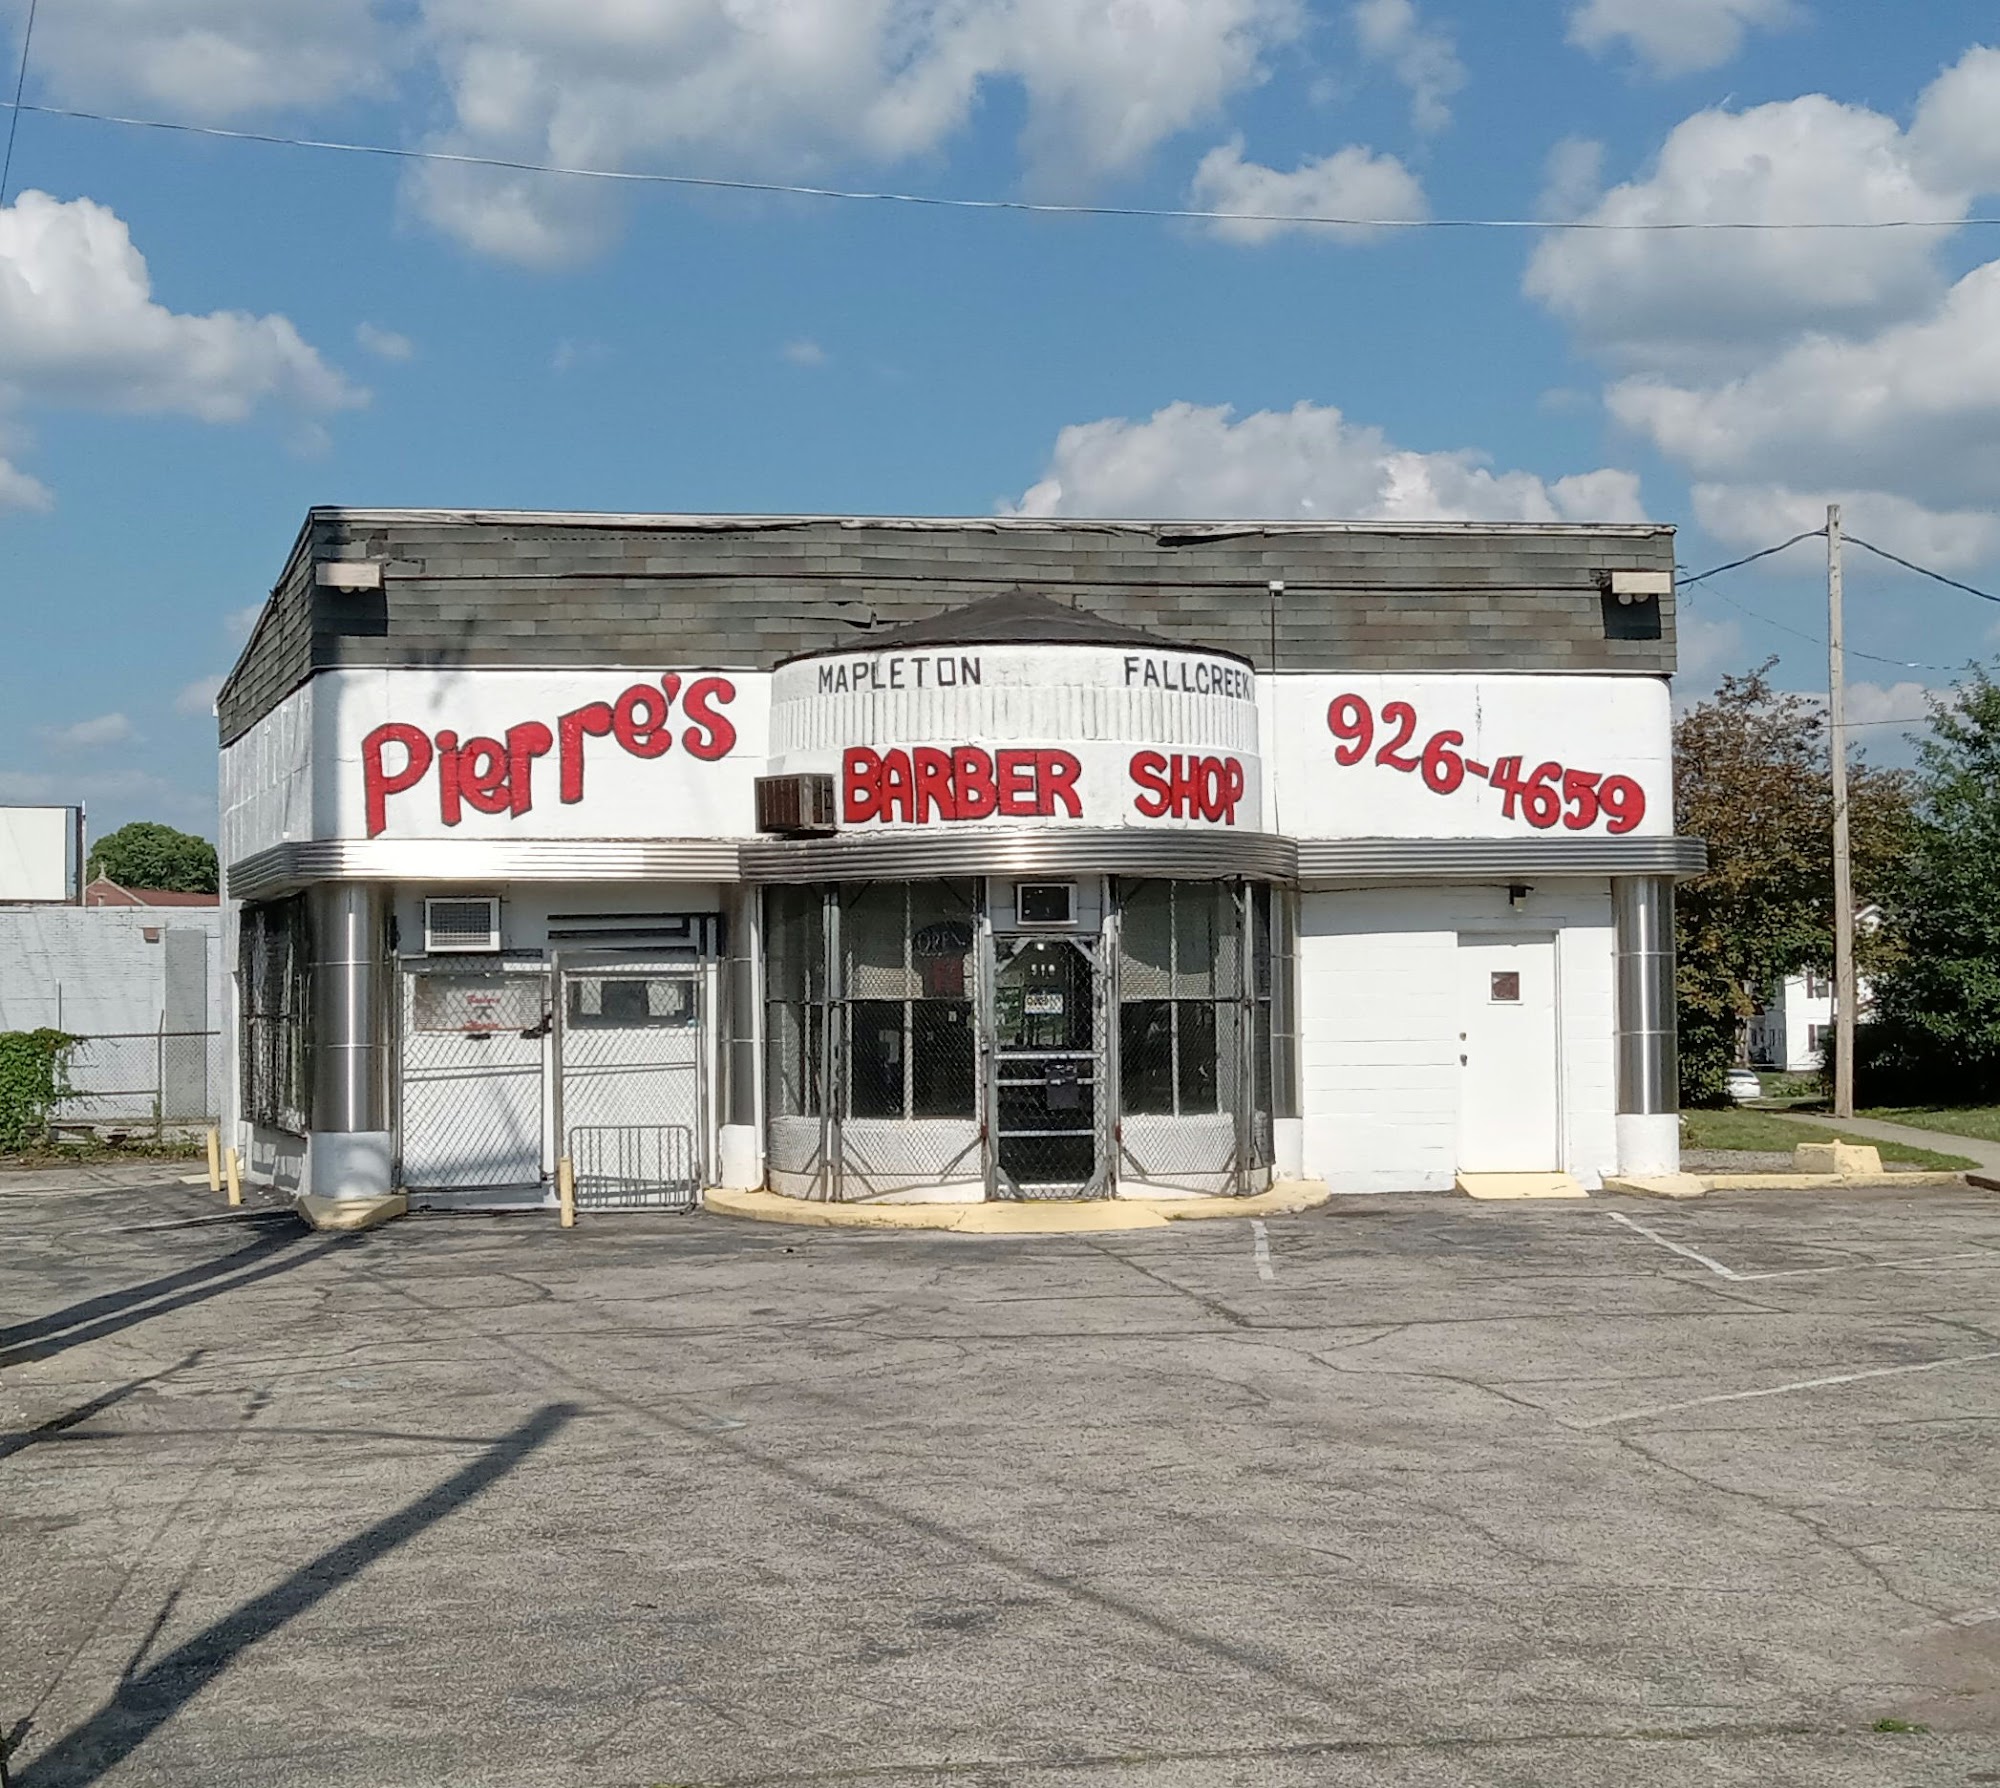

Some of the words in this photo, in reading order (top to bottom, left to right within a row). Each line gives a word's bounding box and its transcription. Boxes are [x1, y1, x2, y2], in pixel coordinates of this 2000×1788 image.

[818, 656, 981, 694] MAPLETON
[843, 746, 1083, 824] BARBER
[1129, 750, 1244, 826] SHOP
[1327, 693, 1646, 834] 926-4659
